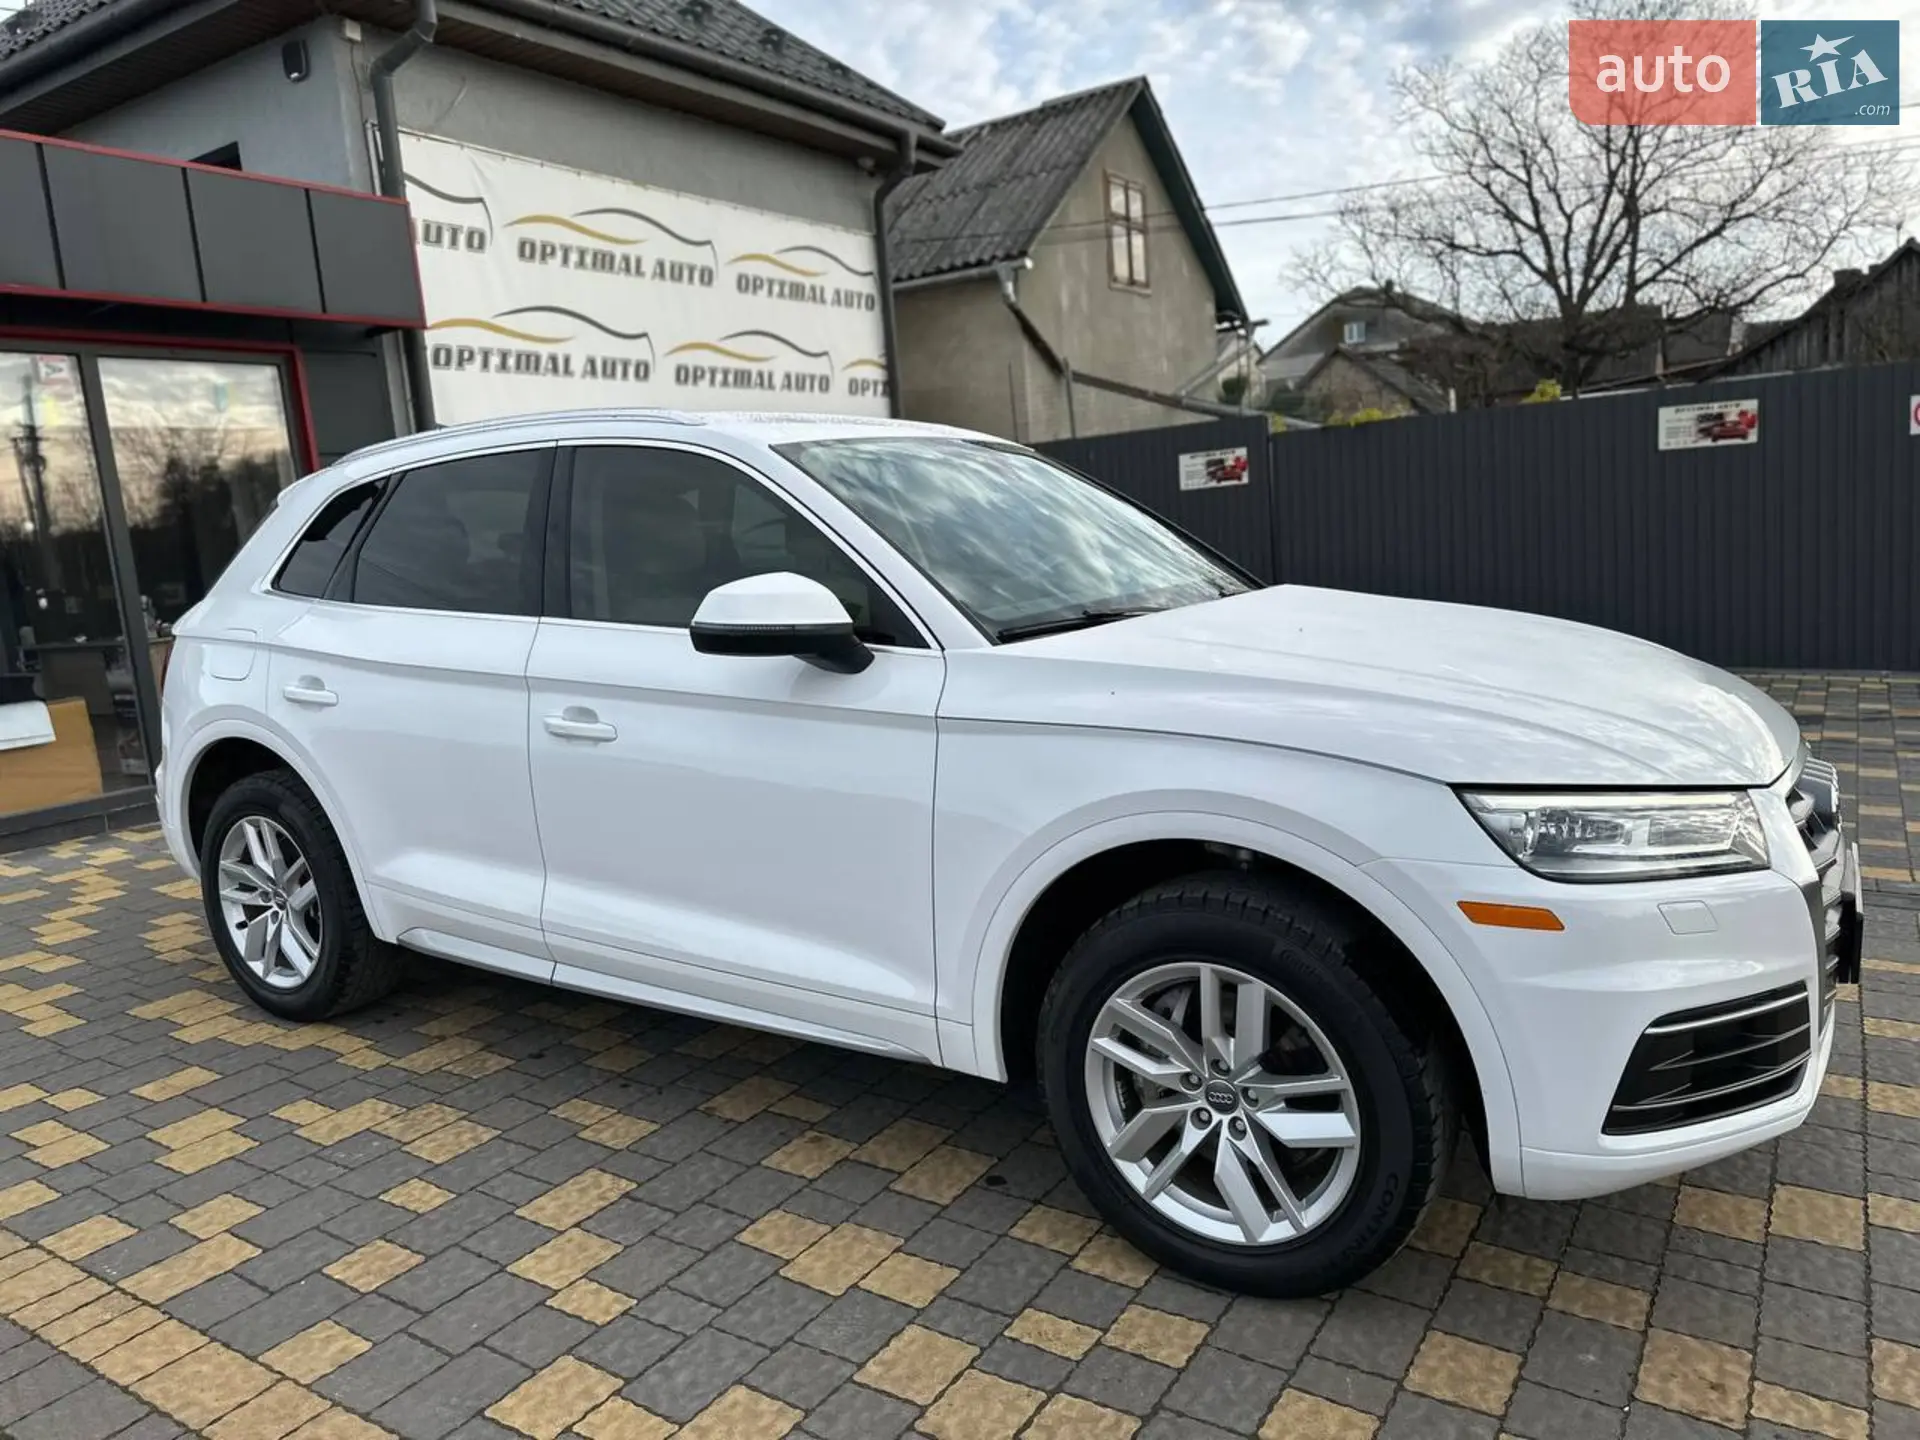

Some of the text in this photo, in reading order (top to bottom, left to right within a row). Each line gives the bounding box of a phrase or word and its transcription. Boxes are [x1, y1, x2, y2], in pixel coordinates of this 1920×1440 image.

[417, 219, 486, 253] UTO
[516, 236, 715, 287] OPTIMAL AUTO
[736, 272, 875, 311] OPTIMAL AUTO
[431, 343, 650, 382] OPTIMAL AUTO
[674, 362, 831, 394] OPTIMAL AUTO
